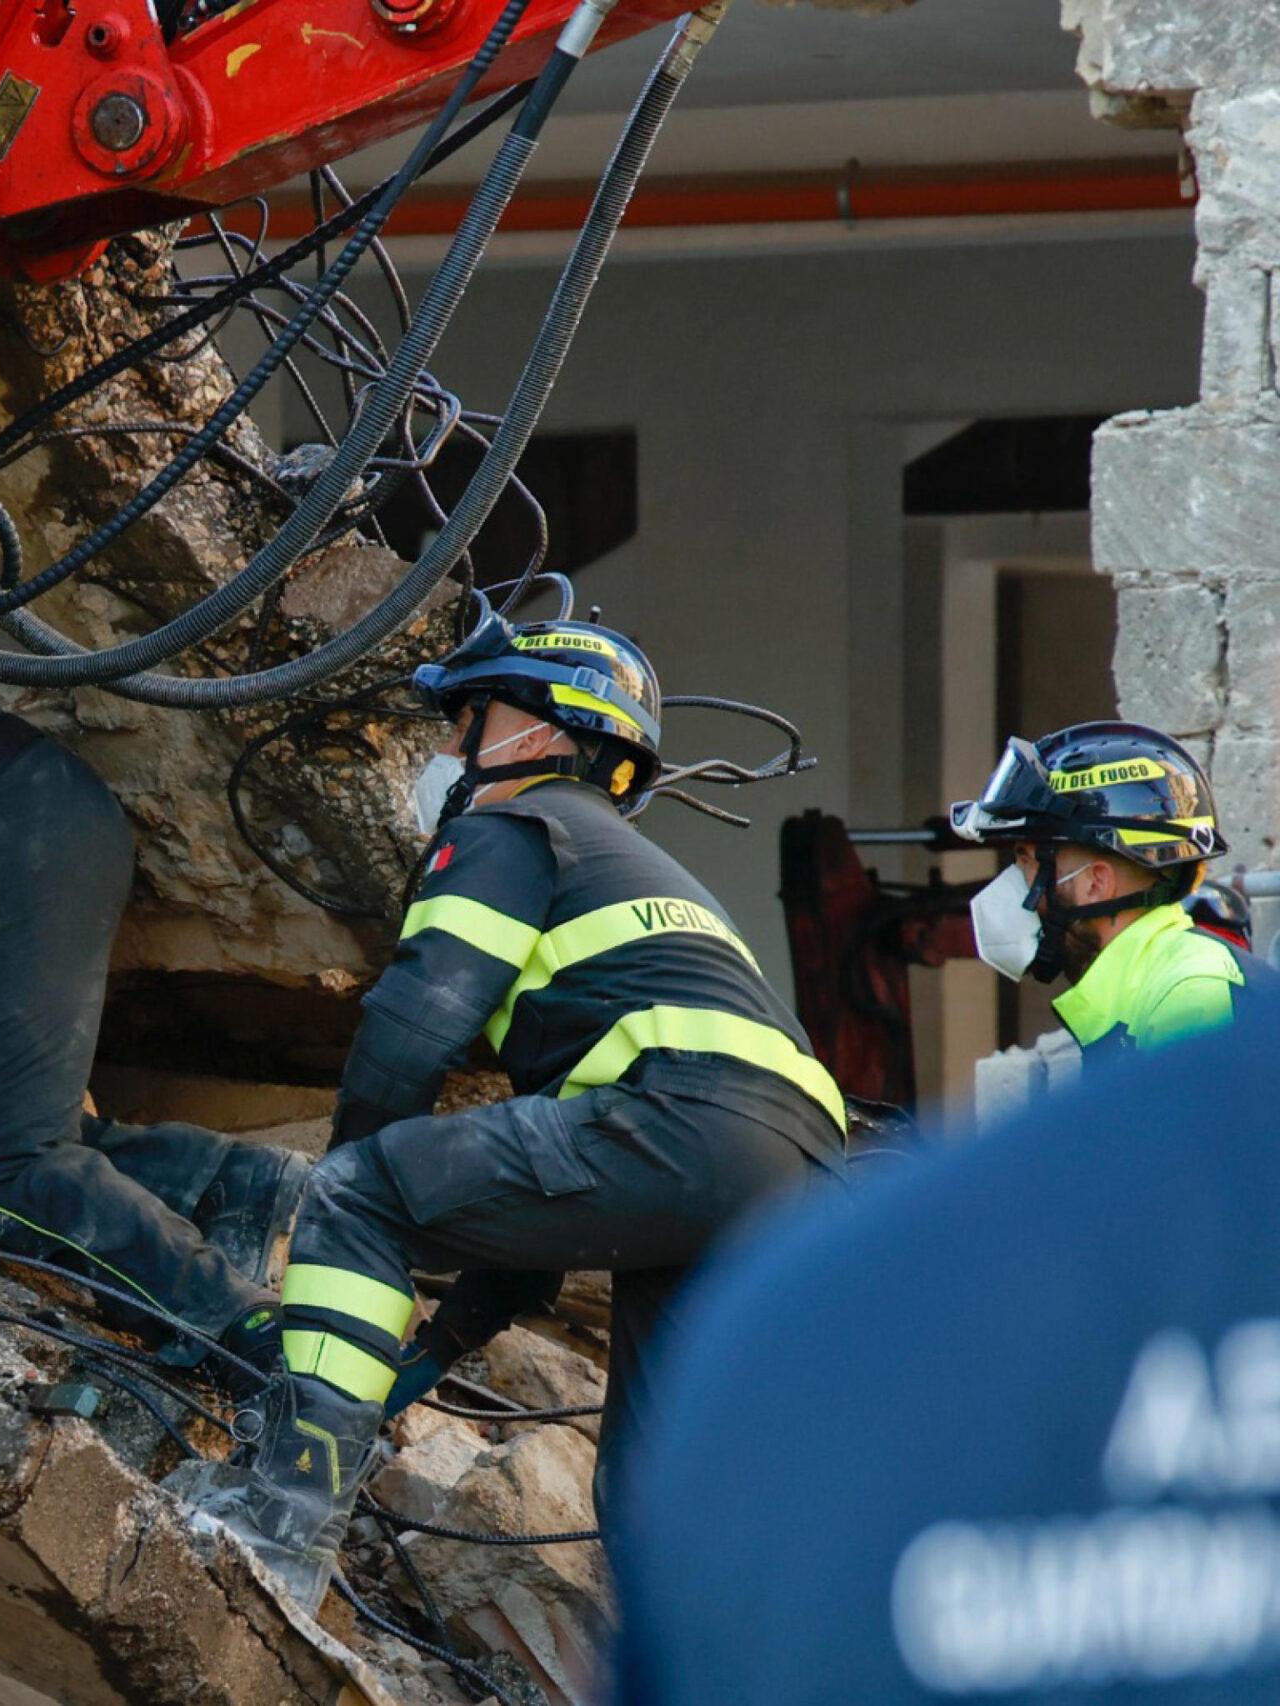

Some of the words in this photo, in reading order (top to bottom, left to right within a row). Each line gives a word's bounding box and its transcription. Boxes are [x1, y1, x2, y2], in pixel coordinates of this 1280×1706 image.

[525, 637, 549, 648] DEL
[554, 636, 603, 650] FUOCO
[1070, 772, 1095, 788] DEL
[1100, 764, 1149, 783] FUOCO
